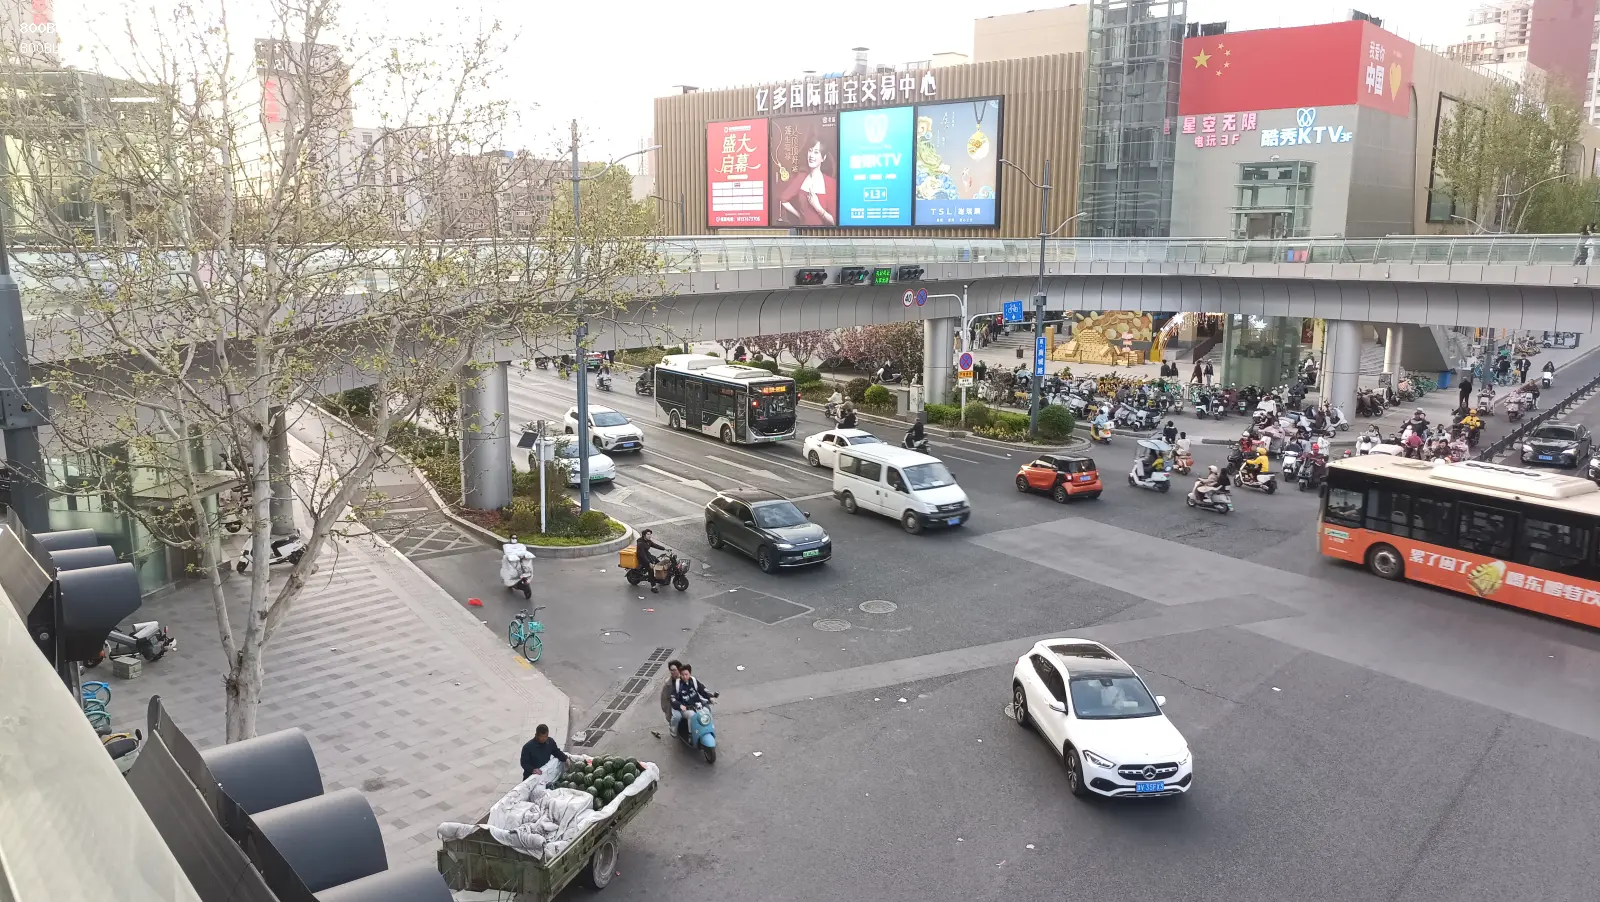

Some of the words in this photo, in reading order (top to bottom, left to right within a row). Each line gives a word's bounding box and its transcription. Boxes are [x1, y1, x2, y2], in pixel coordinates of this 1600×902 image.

[1365, 61, 1385, 97] 中国
[756, 71, 937, 112] 亿多国际珠宝交易中心
[1182, 112, 1258, 134] 星空无限
[721, 133, 757, 154] 盛大
[713, 153, 761, 174] 启幕
[870, 189, 880, 199] L3
[931, 207, 953, 216] TSL
[904, 293, 912, 302] 40
[1409, 548, 1472, 574] 累了困了
